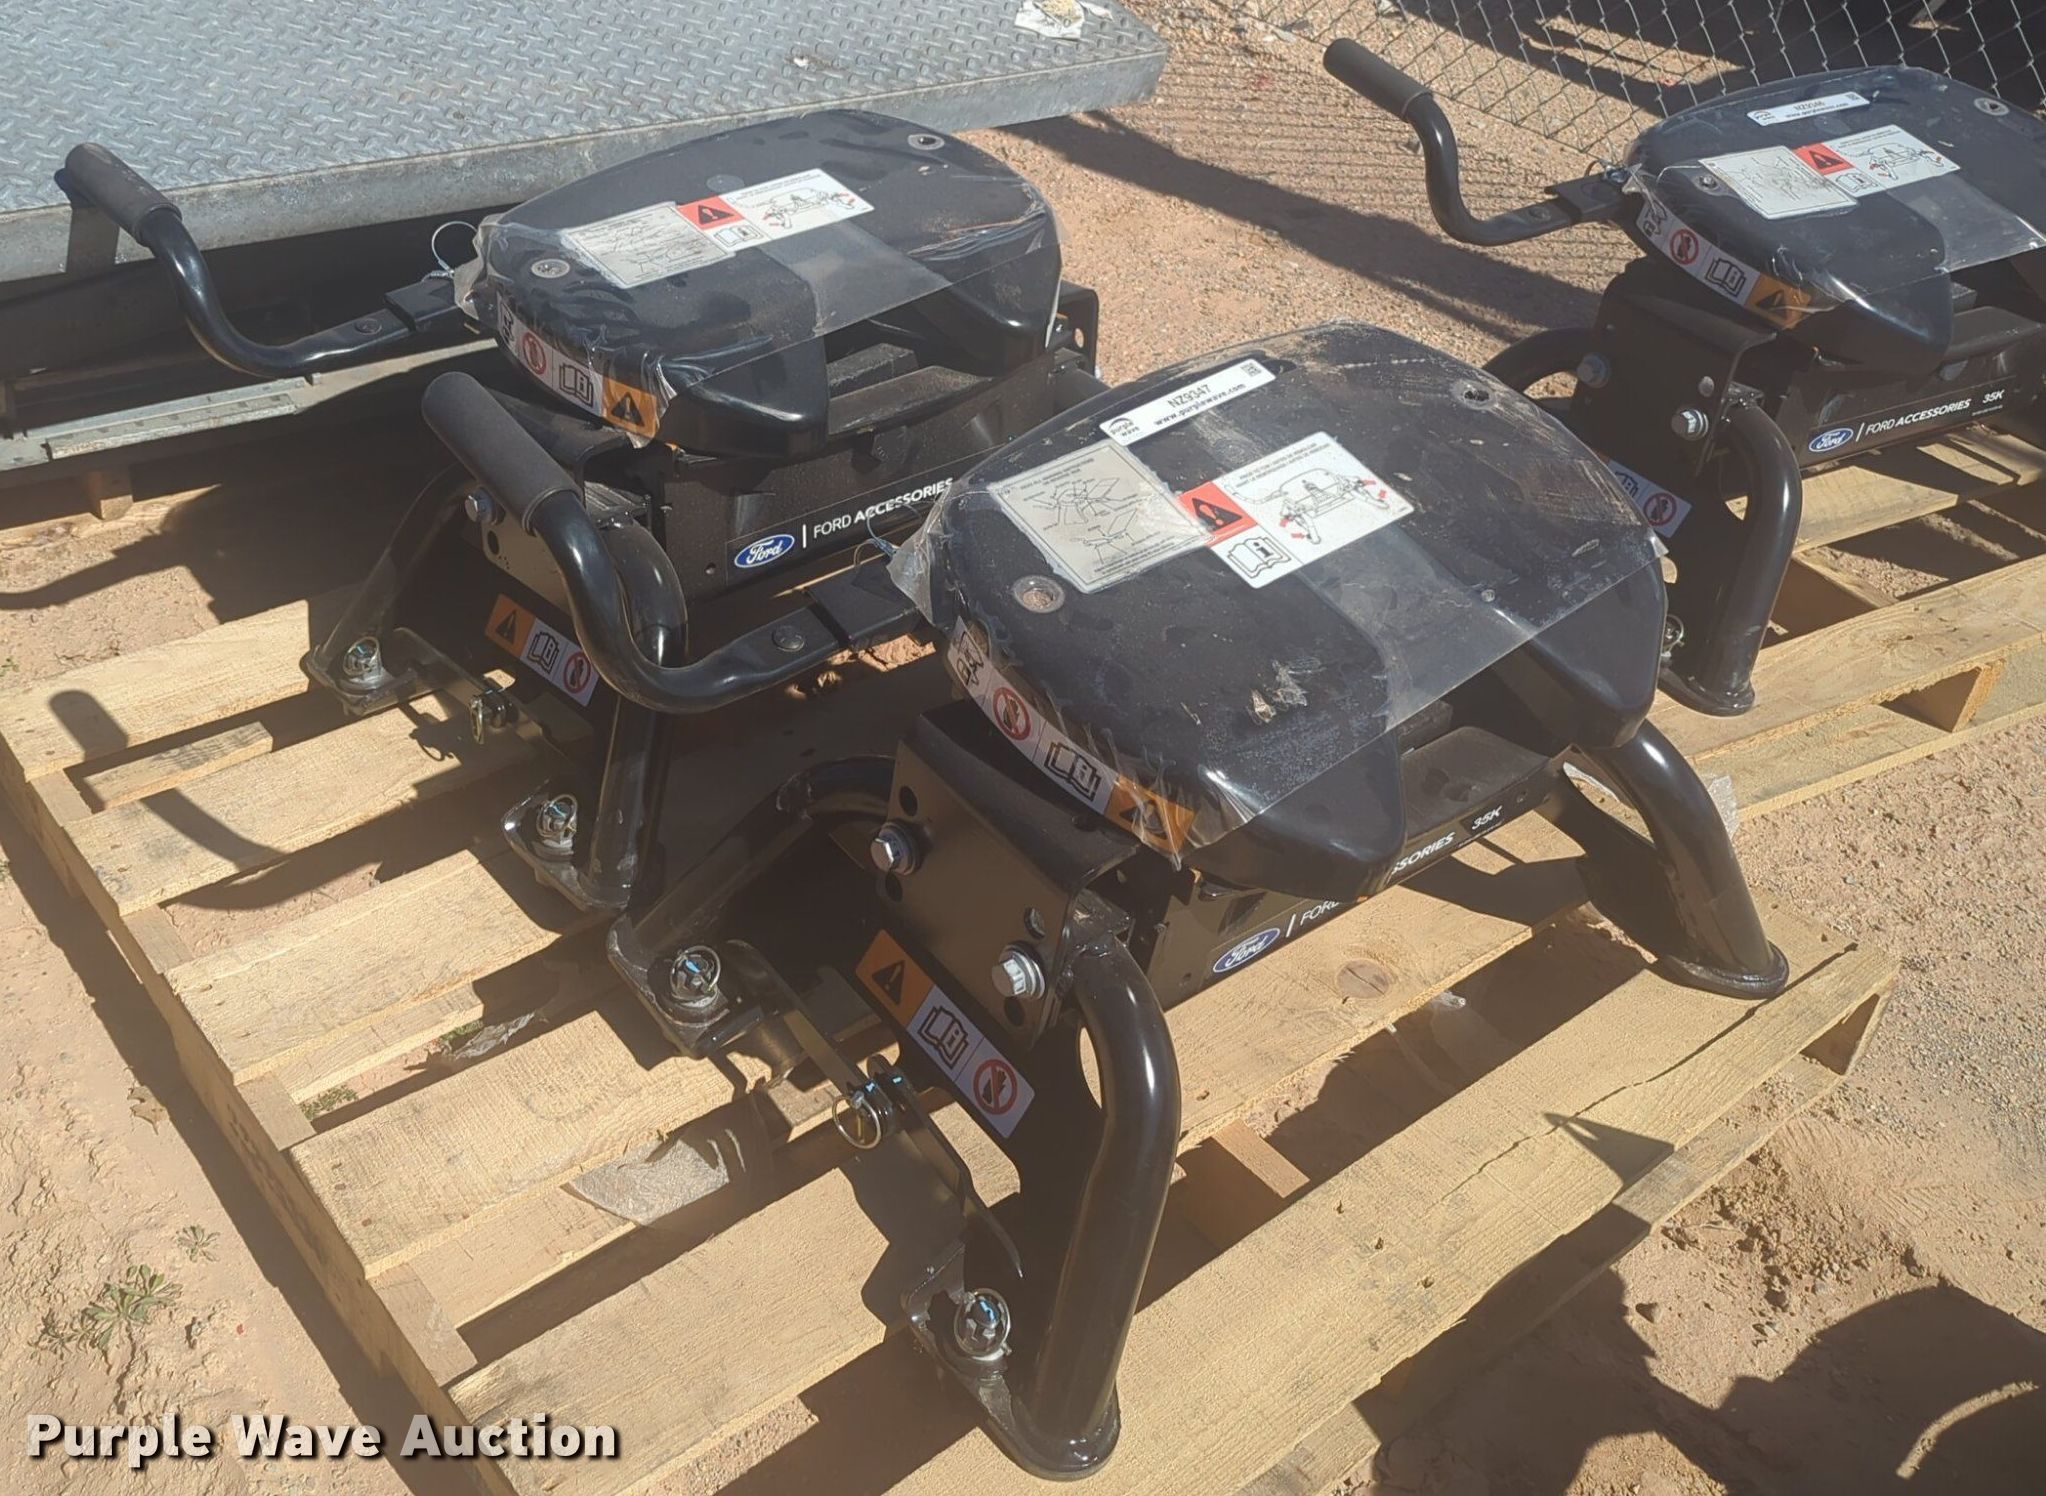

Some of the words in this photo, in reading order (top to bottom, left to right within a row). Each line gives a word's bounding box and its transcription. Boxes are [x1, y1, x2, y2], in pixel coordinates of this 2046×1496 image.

[1154, 384, 1246, 426] www.purplewave.com
[1982, 390, 2005, 403] 35K
[1110, 420, 1134, 435] purple
[1865, 419, 1895, 435] FORD
[1895, 399, 1971, 427] ACCESSORIES
[1121, 426, 1140, 437] wave
[813, 514, 851, 538] FORD
[1471, 806, 1502, 831] 35K
